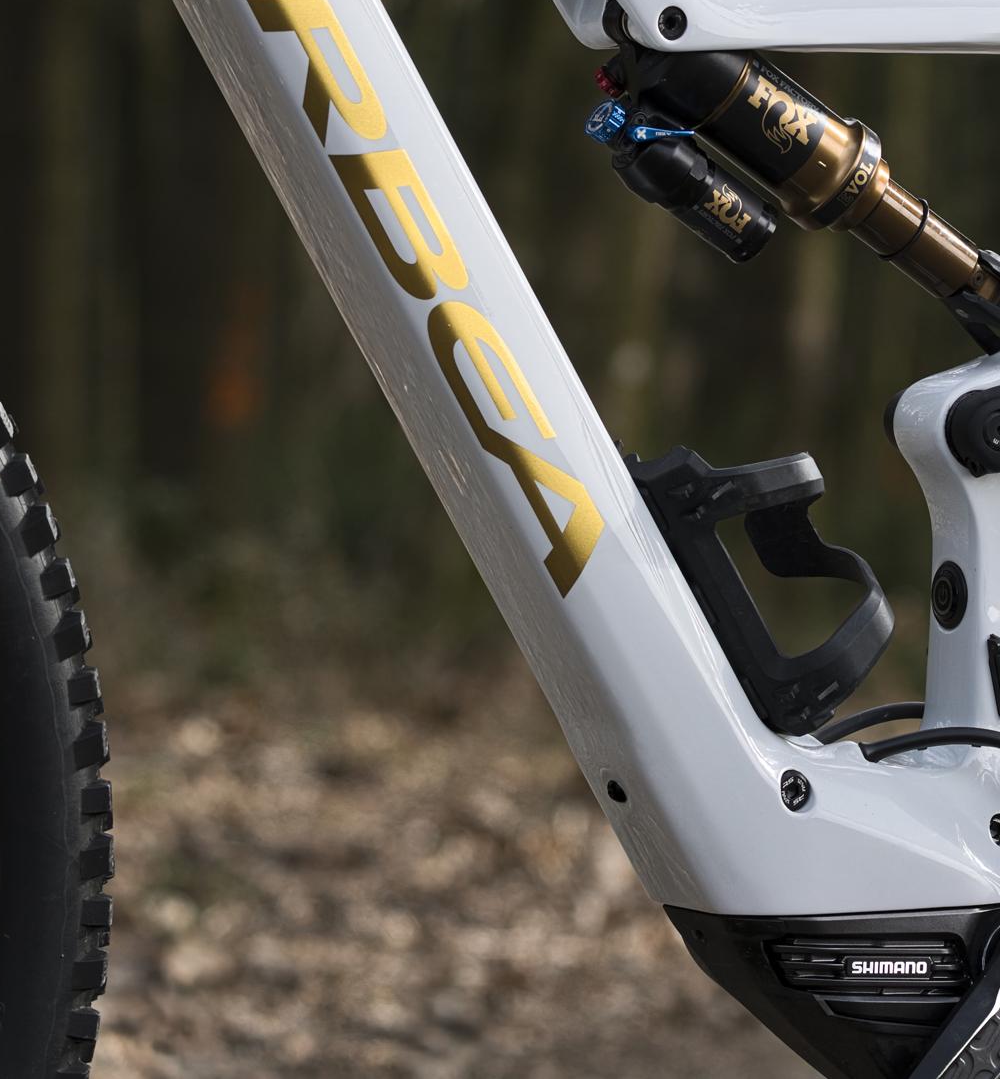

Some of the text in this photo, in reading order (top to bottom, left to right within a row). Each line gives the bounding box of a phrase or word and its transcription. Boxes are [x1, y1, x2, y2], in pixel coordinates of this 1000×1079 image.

[747, 75, 818, 154] FOX
[703, 184, 752, 234] FOX
[851, 961, 928, 975] SHIMANO
